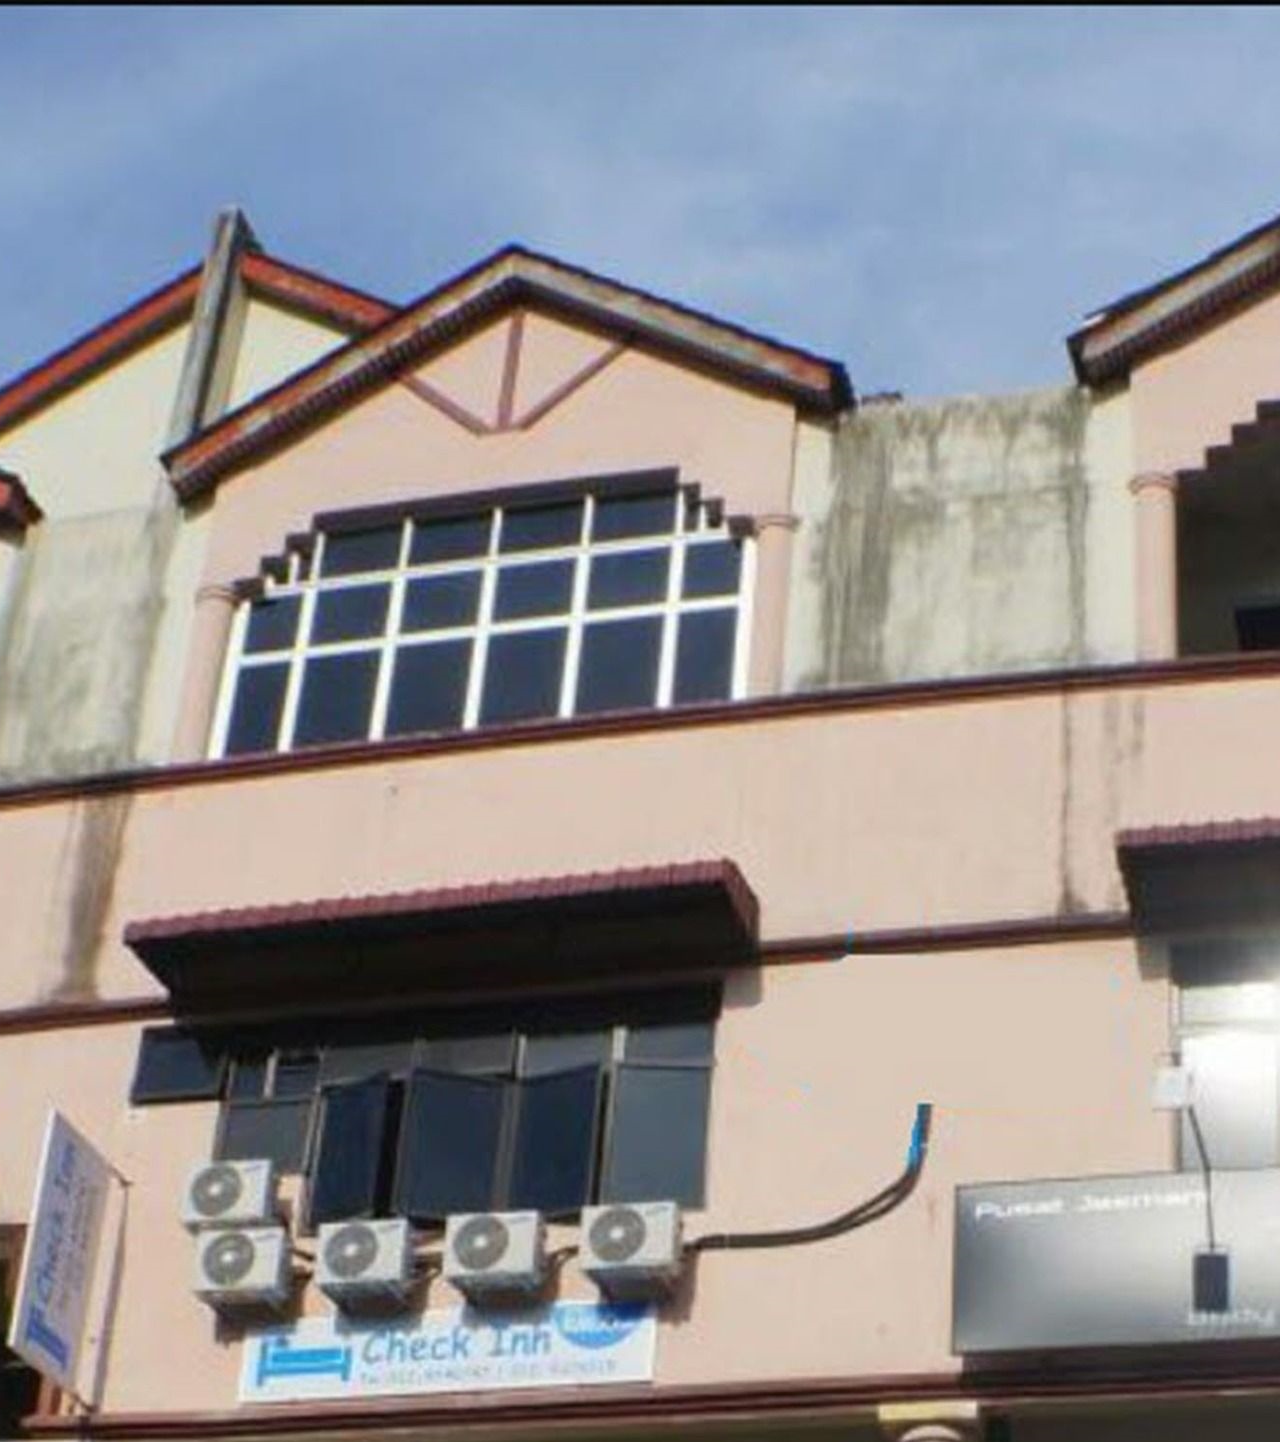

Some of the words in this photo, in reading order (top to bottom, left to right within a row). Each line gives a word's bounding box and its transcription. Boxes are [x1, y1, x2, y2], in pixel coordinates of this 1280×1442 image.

[975, 1200, 1063, 1223] Pusat
[1080, 1191, 1207, 1212] Jasman
[362, 1325, 470, 1365] Check
[486, 1322, 551, 1358] Inn
